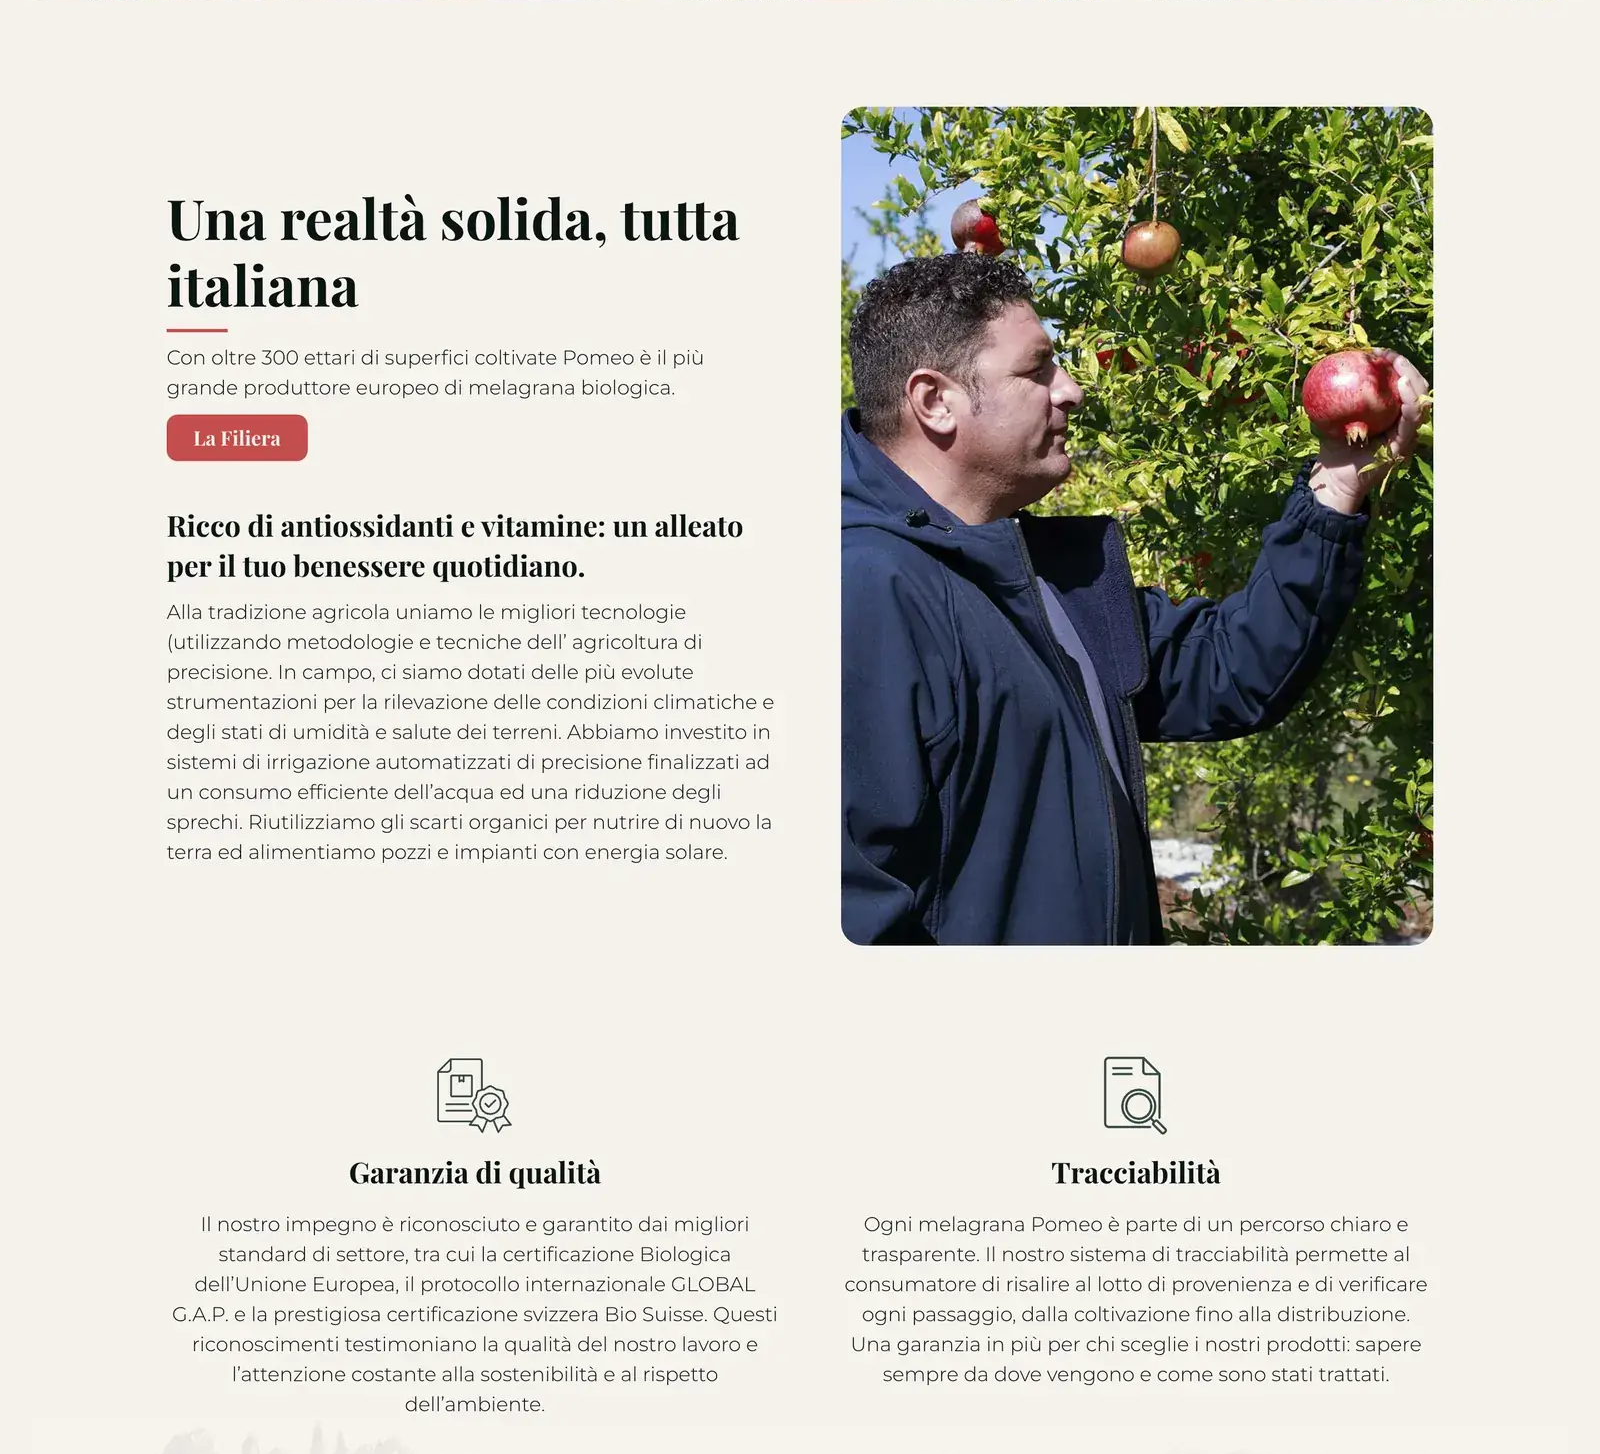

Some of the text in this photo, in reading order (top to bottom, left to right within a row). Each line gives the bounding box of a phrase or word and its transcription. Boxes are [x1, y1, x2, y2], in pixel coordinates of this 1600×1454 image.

[167, 193, 741, 249] Una realtà solida, tutta
[167, 262, 360, 309] italiana
[166, 378, 675, 400] grande produttore europeo di melagrana biologica.
[193, 429, 281, 447] La Filiera
[167, 513, 743, 538] Ricco di antiossidanti e vitamine: un alleato
[166, 553, 585, 583] per il tuo benessere quotidiano.
[349, 1158, 602, 1190] Garanzia di qualità
[1051, 1158, 1222, 1185] Tracciabilità
[862, 1305, 1410, 1326] ogni passaggio, dalla coltivazione fino alla distribuzione.
[405, 1395, 545, 1413] dell’ambiente.
